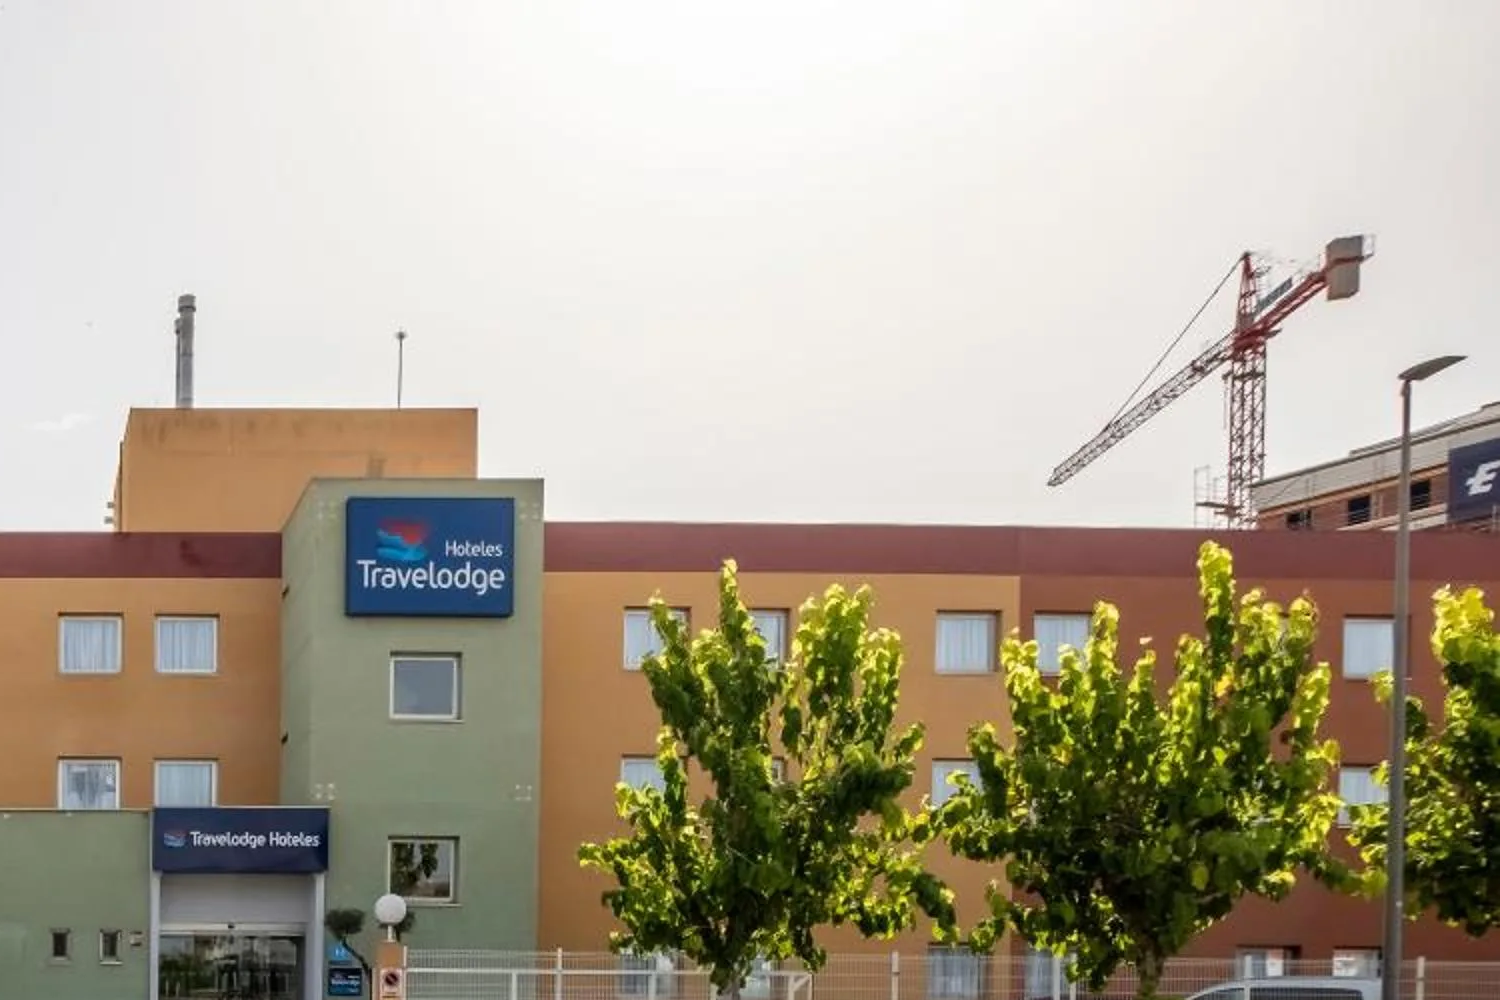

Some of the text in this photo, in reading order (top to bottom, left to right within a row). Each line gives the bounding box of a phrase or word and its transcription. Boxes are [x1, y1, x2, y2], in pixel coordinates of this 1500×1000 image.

[445, 540, 503, 557] Hoteles
[356, 559, 506, 595] Travelodge
[189, 831, 320, 849] Travelodge Hoteles
